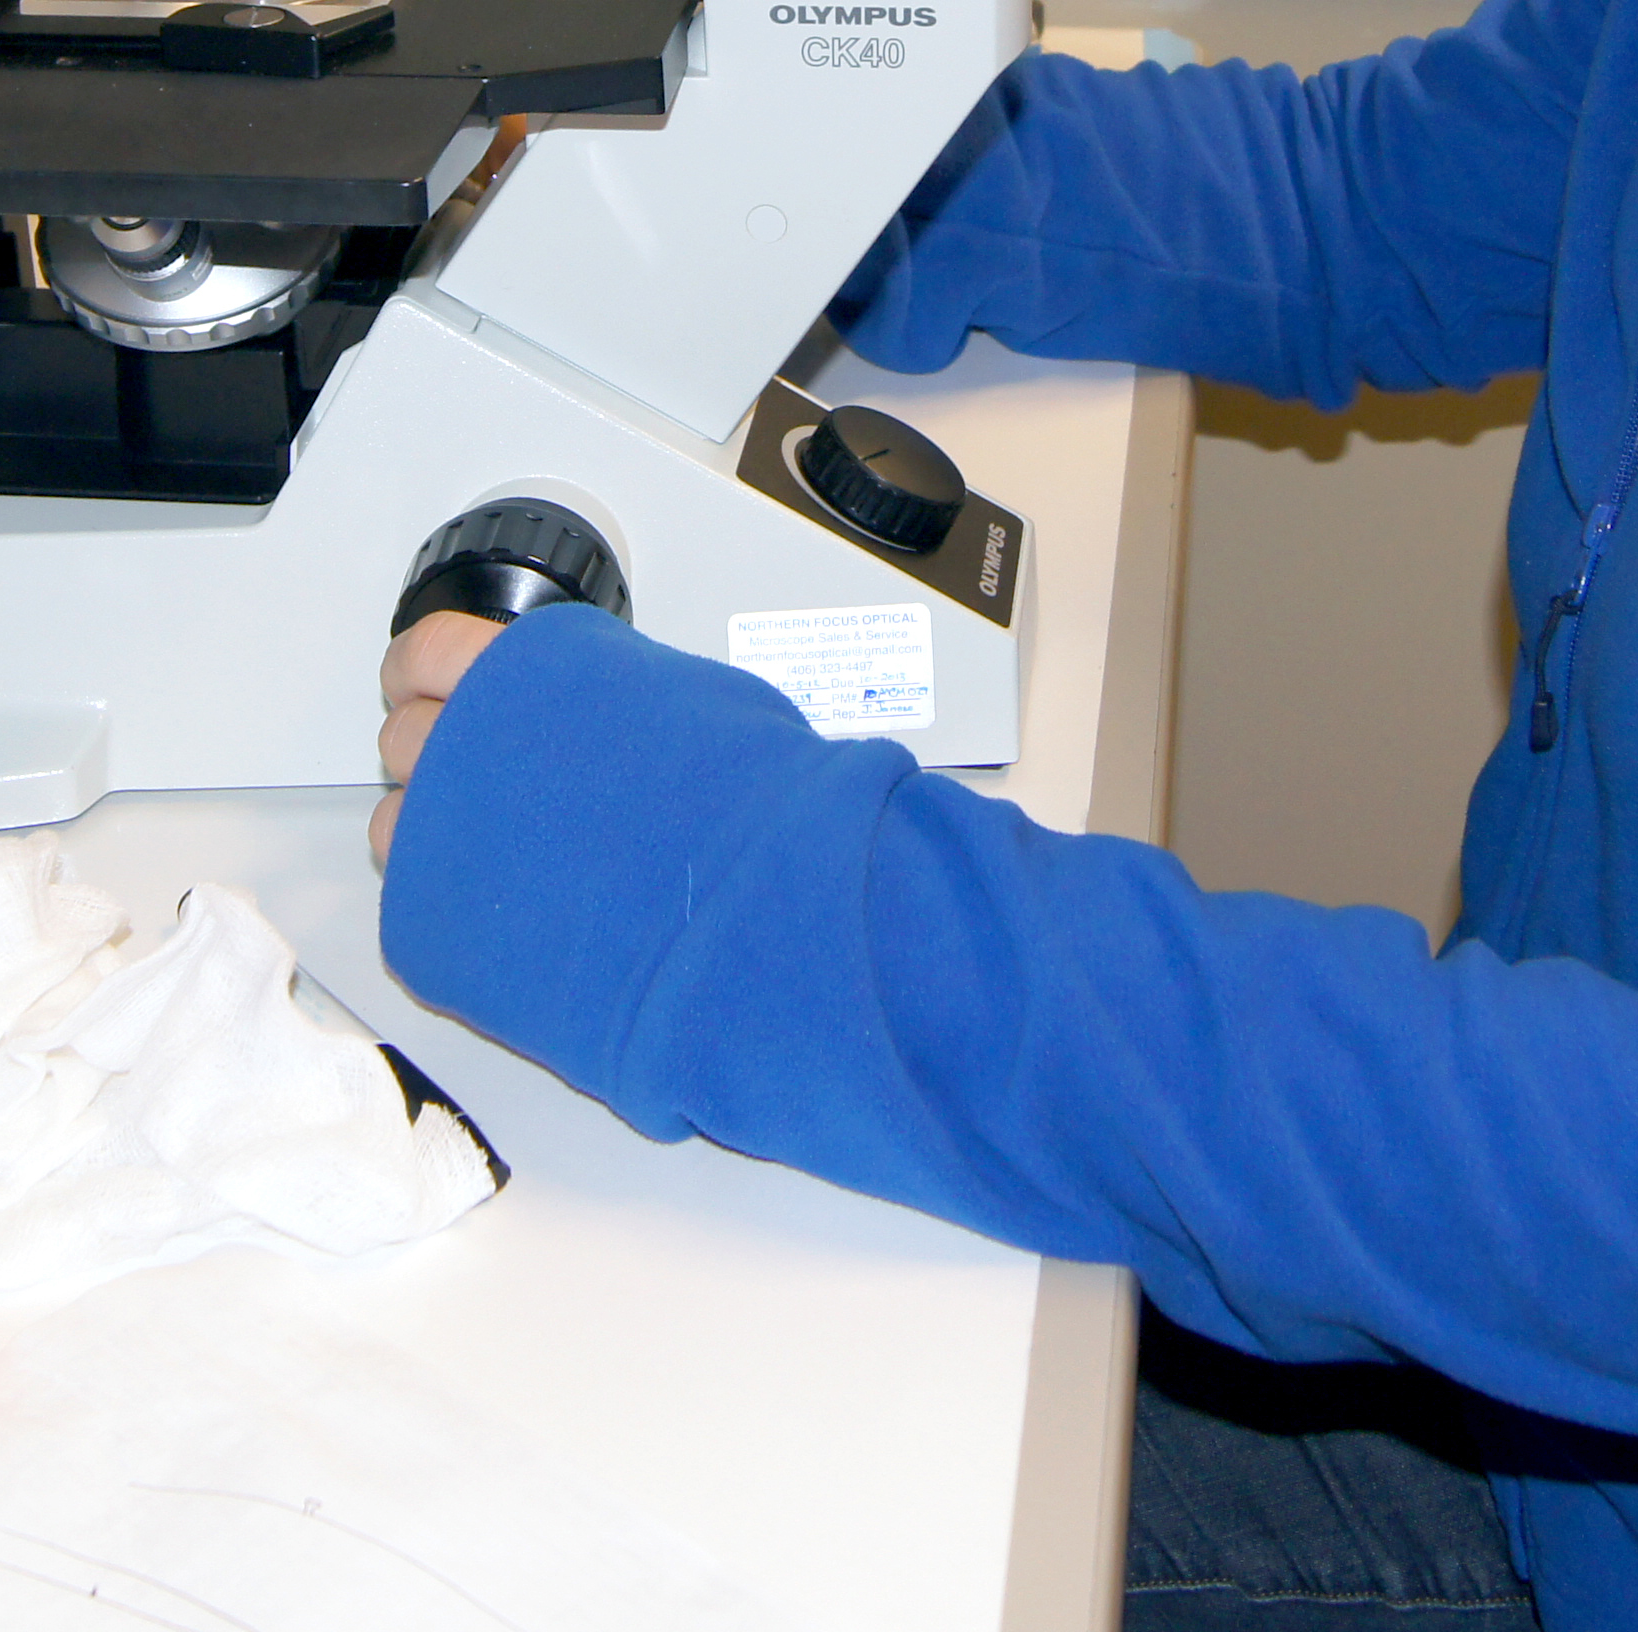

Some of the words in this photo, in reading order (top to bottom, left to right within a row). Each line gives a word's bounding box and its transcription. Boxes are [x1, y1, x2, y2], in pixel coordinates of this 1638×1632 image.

[769, 4, 938, 28] OLYMPUS
[800, 36, 906, 69] CK40
[978, 522, 1007, 598] OLYMPUS
[738, 618, 810, 632] NORTHERN
[814, 615, 859, 627] FOCUS
[861, 612, 918, 625] OPTICAL
[749, 635, 815, 647] Microscope
[818, 632, 850, 643] Sales
[853, 630, 862, 641] &
[865, 629, 908, 640] Service
[786, 666, 816, 678] (406)
[819, 661, 873, 674] 323-4497
[831, 677, 854, 689] Due
[832, 692, 858, 705] PM#
[833, 708, 856, 721] Rep
